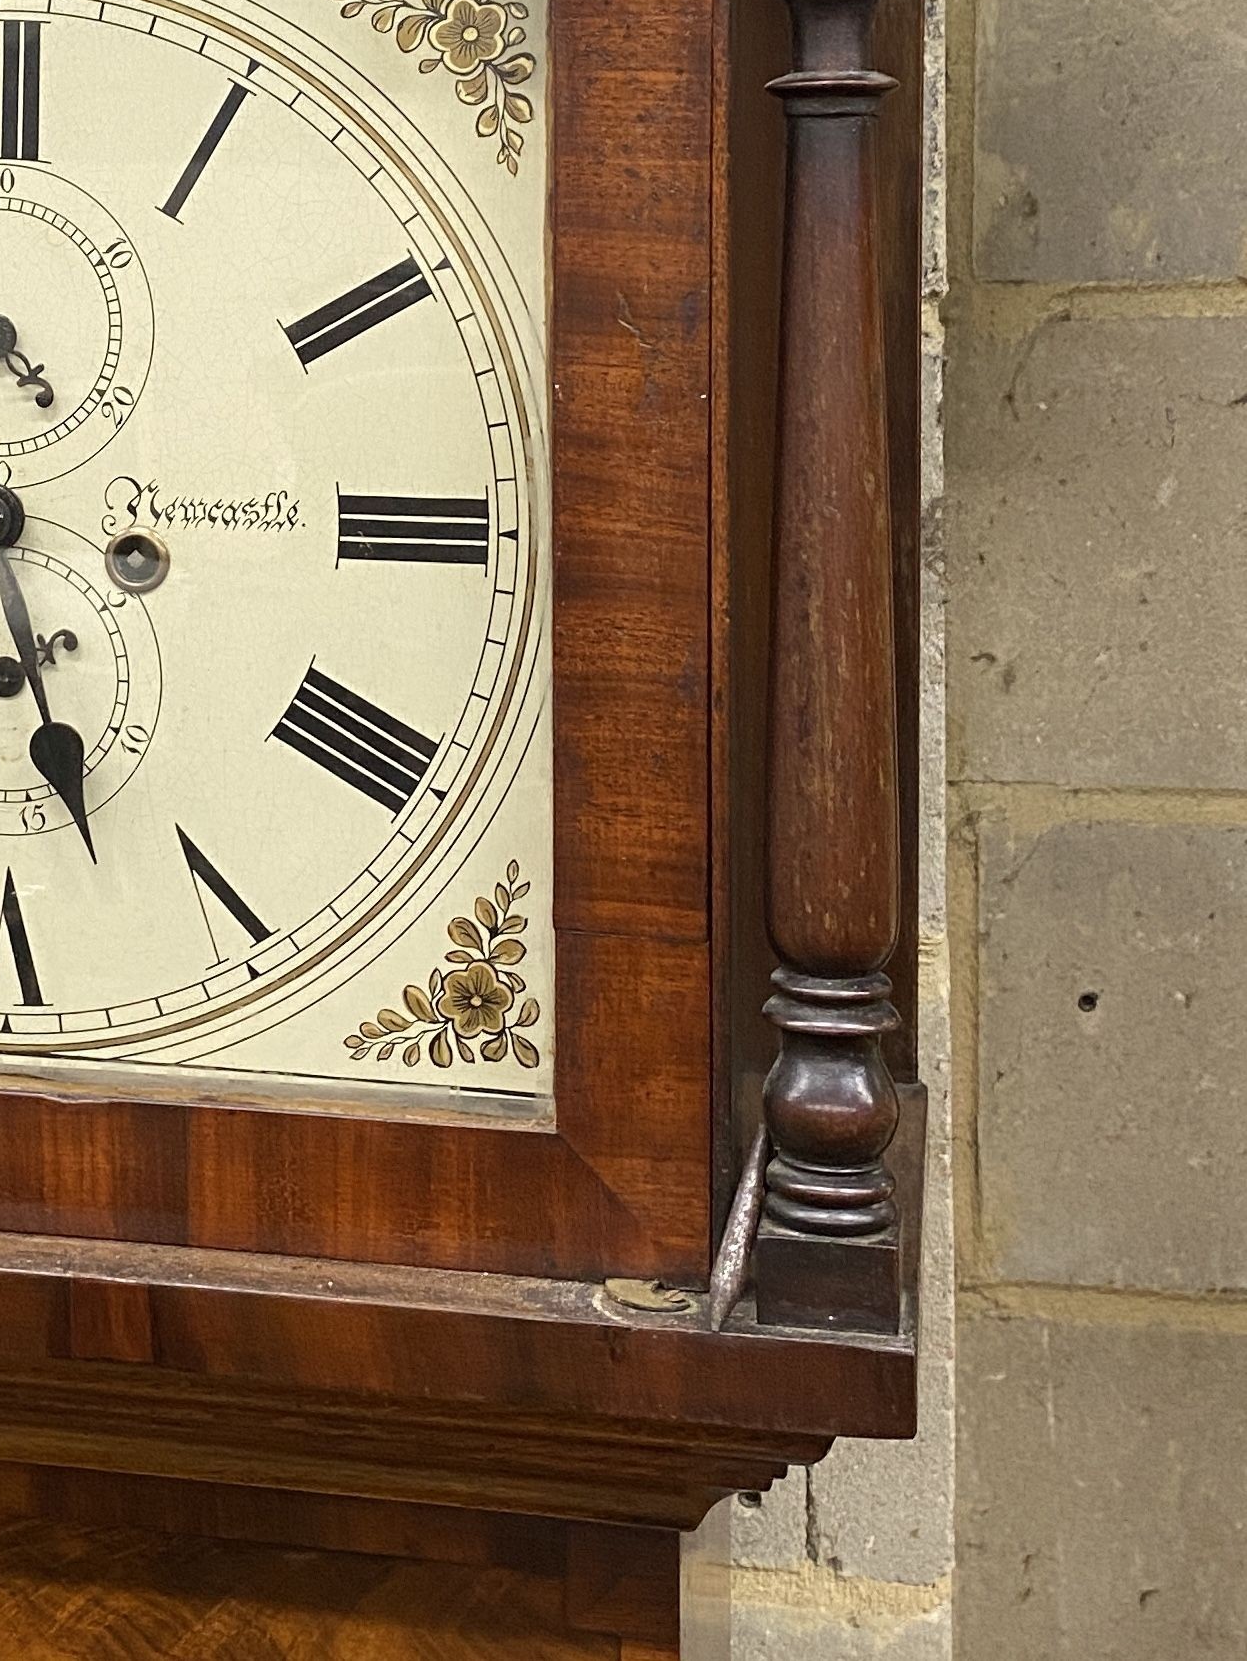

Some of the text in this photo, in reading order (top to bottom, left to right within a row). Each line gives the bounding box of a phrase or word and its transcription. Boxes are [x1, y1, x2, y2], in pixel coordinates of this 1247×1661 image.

[154, 77, 258, 226] I
[103, 237, 134, 270] 10
[276, 248, 438, 375] II
[101, 385, 135, 429] 20
[336, 481, 488, 579] III
[120, 724, 154, 756] 10
[265, 654, 446, 824] IIII
[19, 803, 47, 833] 15
[175, 822, 281, 971] V
